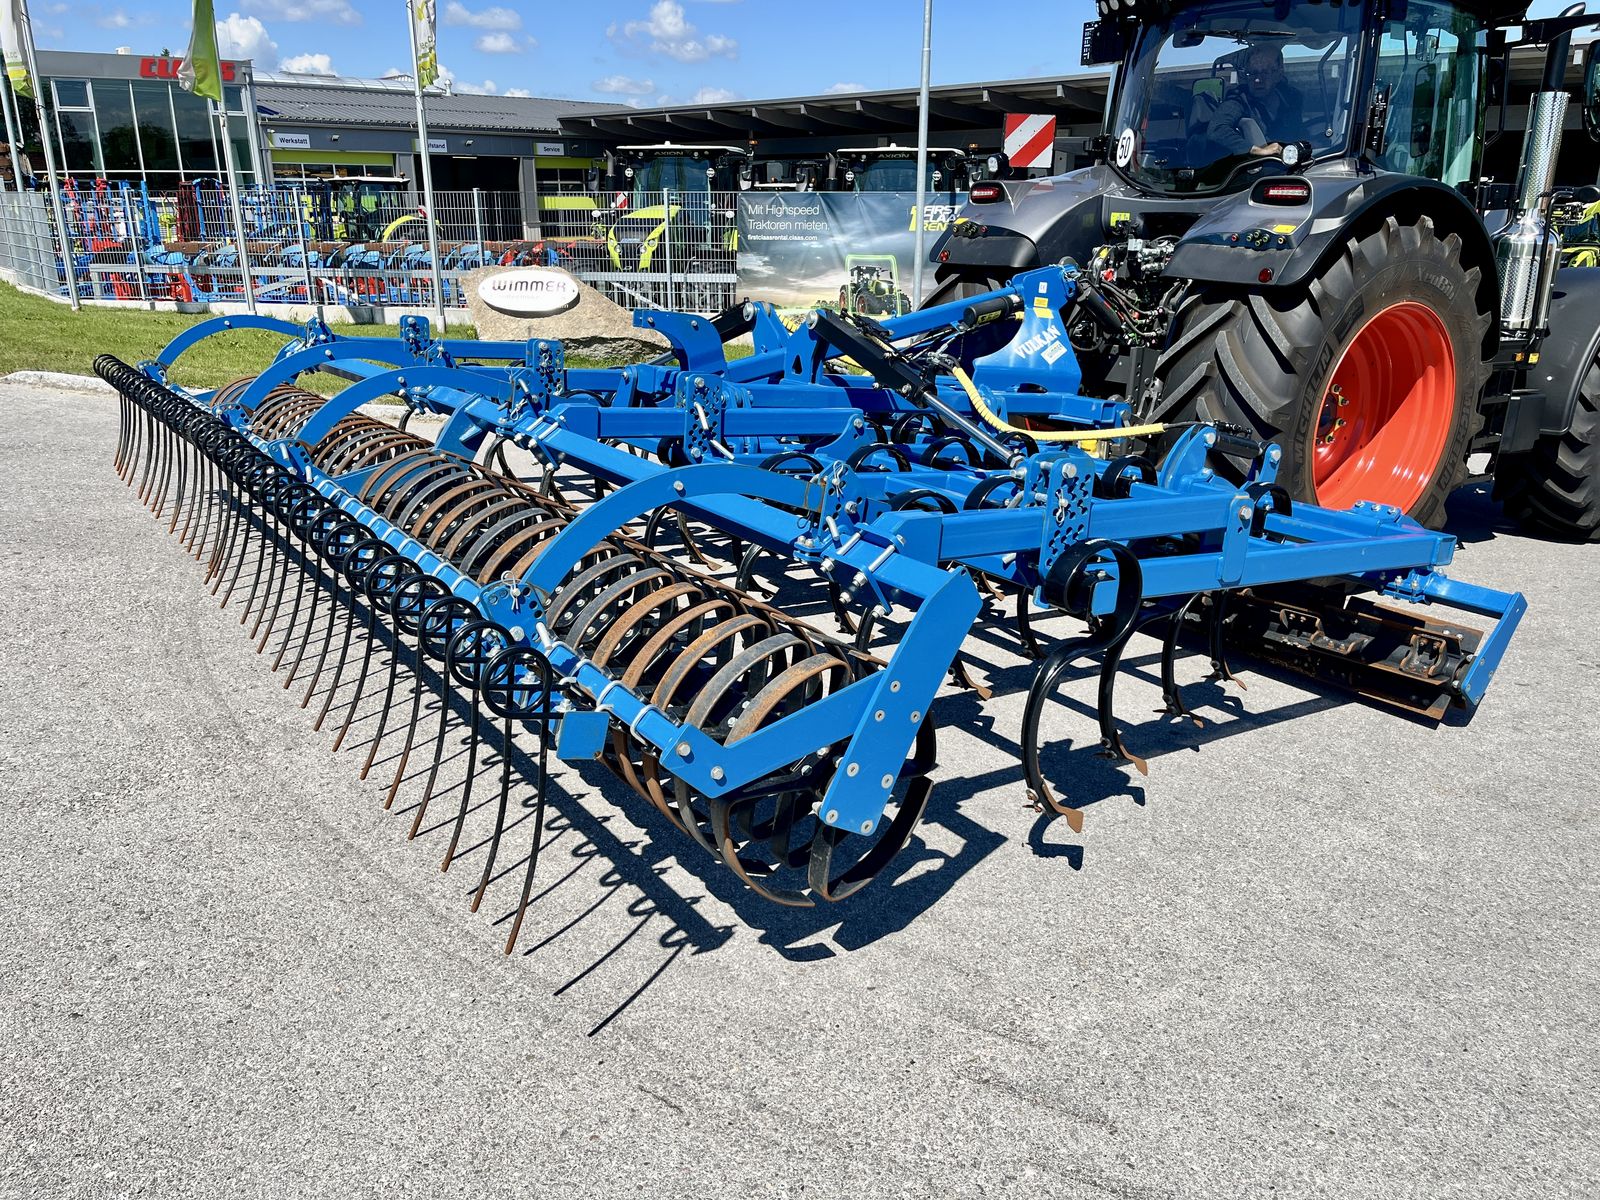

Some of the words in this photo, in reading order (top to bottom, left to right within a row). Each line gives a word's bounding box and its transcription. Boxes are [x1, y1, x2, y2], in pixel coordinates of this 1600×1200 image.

[140, 58, 236, 80] CLS
[279, 136, 308, 145] Werkstatt
[1119, 136, 1131, 159] 50
[748, 204, 764, 215] Mit
[766, 204, 820, 217] Highspeed
[923, 205, 962, 215] FIRST
[923, 213, 960, 223] CLAA
[747, 219, 792, 230] Traktoren
[794, 220, 830, 231] mieten.
[492, 280, 567, 292] WIMMER
[1015, 324, 1062, 359] VULKAN
[1294, 342, 1333, 465] MICHELIN
